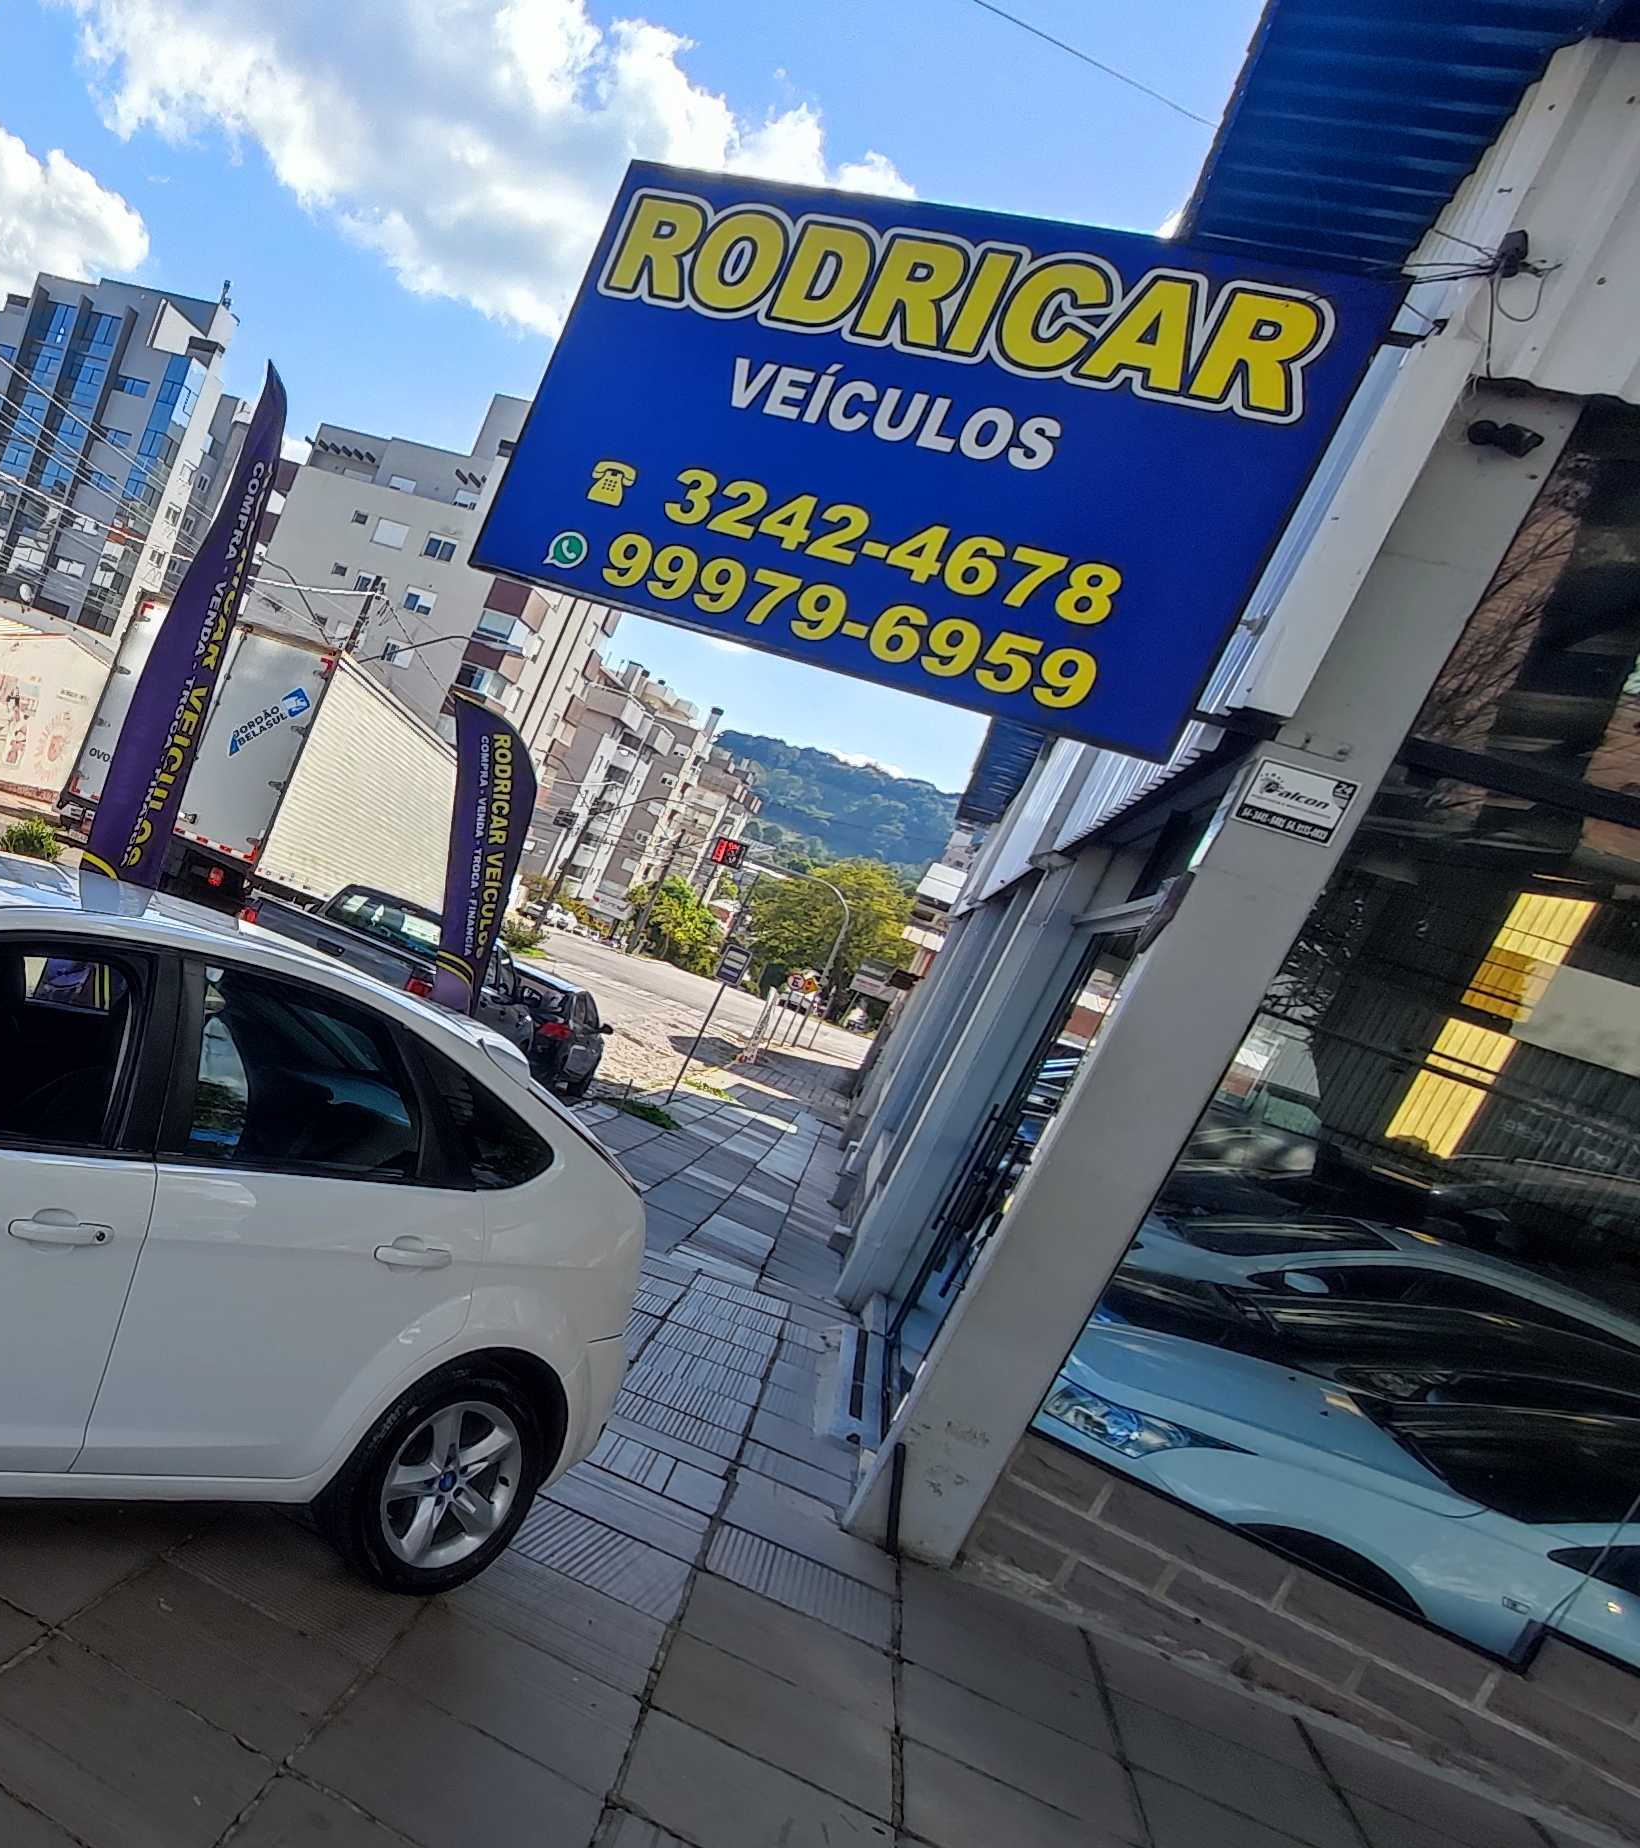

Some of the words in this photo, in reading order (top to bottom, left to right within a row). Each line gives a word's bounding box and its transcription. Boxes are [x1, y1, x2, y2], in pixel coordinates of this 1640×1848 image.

[602, 191, 1326, 419] RODRICAR
[729, 357, 1063, 472] VEÍCULOS
[225, 461, 265, 560] COMPRA
[664, 468, 1123, 626] 3242-4678
[194, 581, 227, 657] VENDA
[602, 532, 1099, 709] 99979-6959
[238, 713, 288, 746] BELASUL
[480, 735, 490, 787] COMPRA
[475, 797, 487, 838] VENDA
[488, 734, 512, 844] RODRICAR
[471, 848, 482, 889] TROCA
[464, 899, 478, 956] FINANCIA
